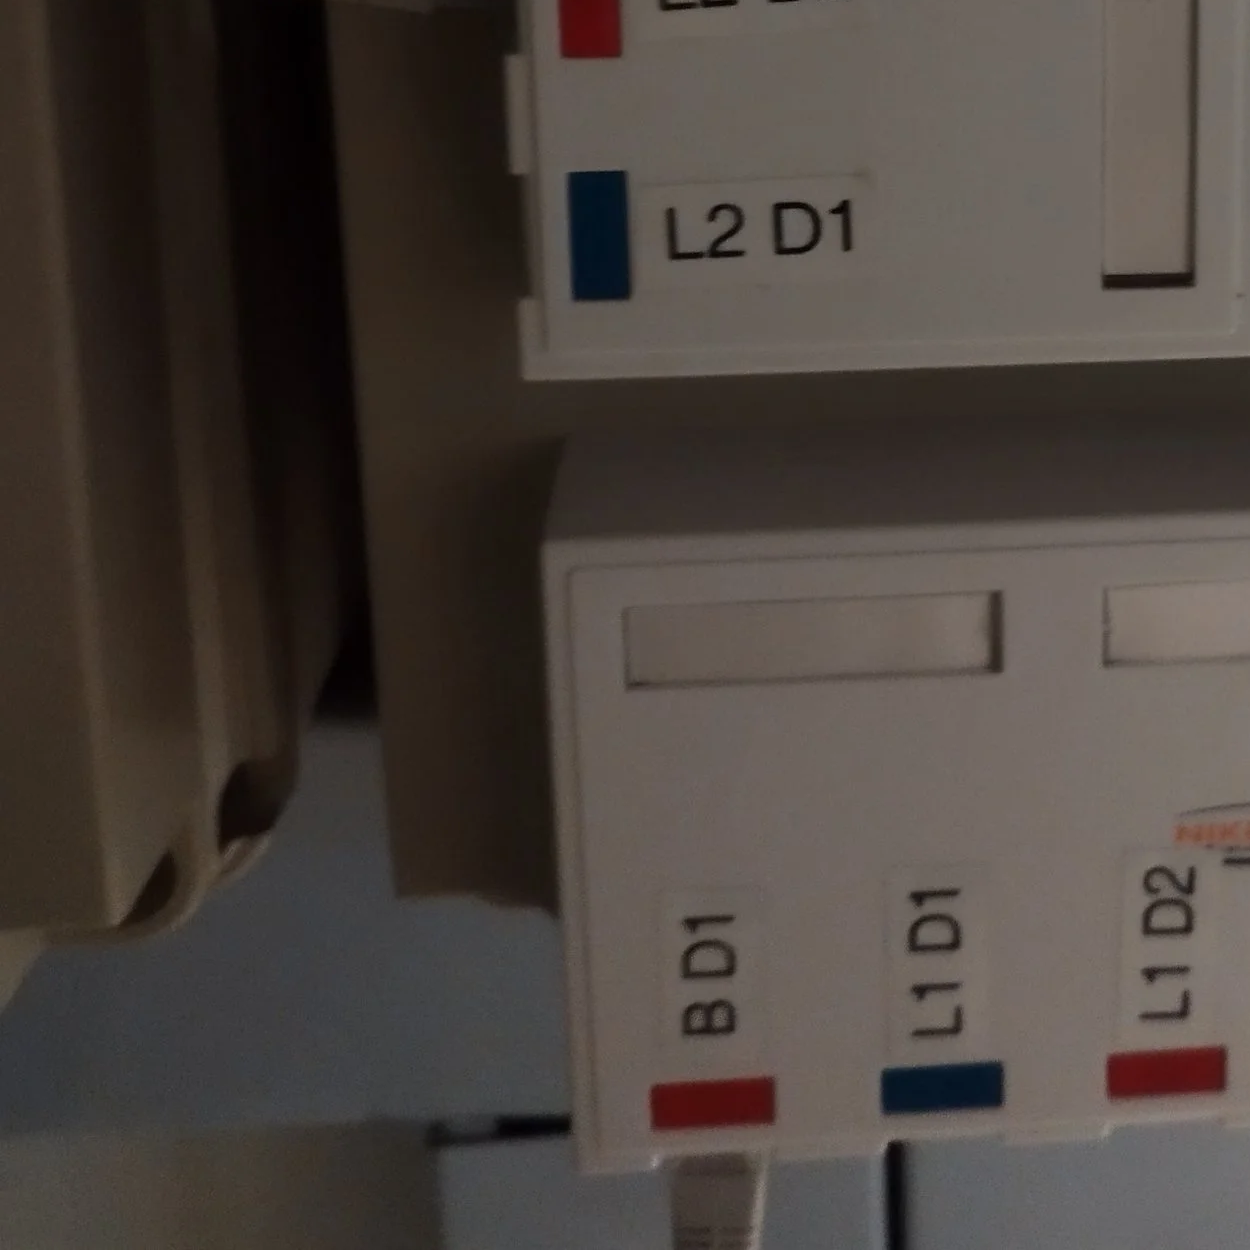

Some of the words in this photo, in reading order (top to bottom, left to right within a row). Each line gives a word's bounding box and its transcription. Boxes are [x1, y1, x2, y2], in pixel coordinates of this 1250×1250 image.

[665, 203, 745, 261] L2
[772, 199, 852, 256] D1
[907, 889, 962, 953] D1
[1142, 866, 1196, 936] D2
[681, 915, 736, 980] D1
[682, 999, 737, 1037] B
[910, 982, 963, 1038] L1
[1139, 965, 1191, 1021] L1
